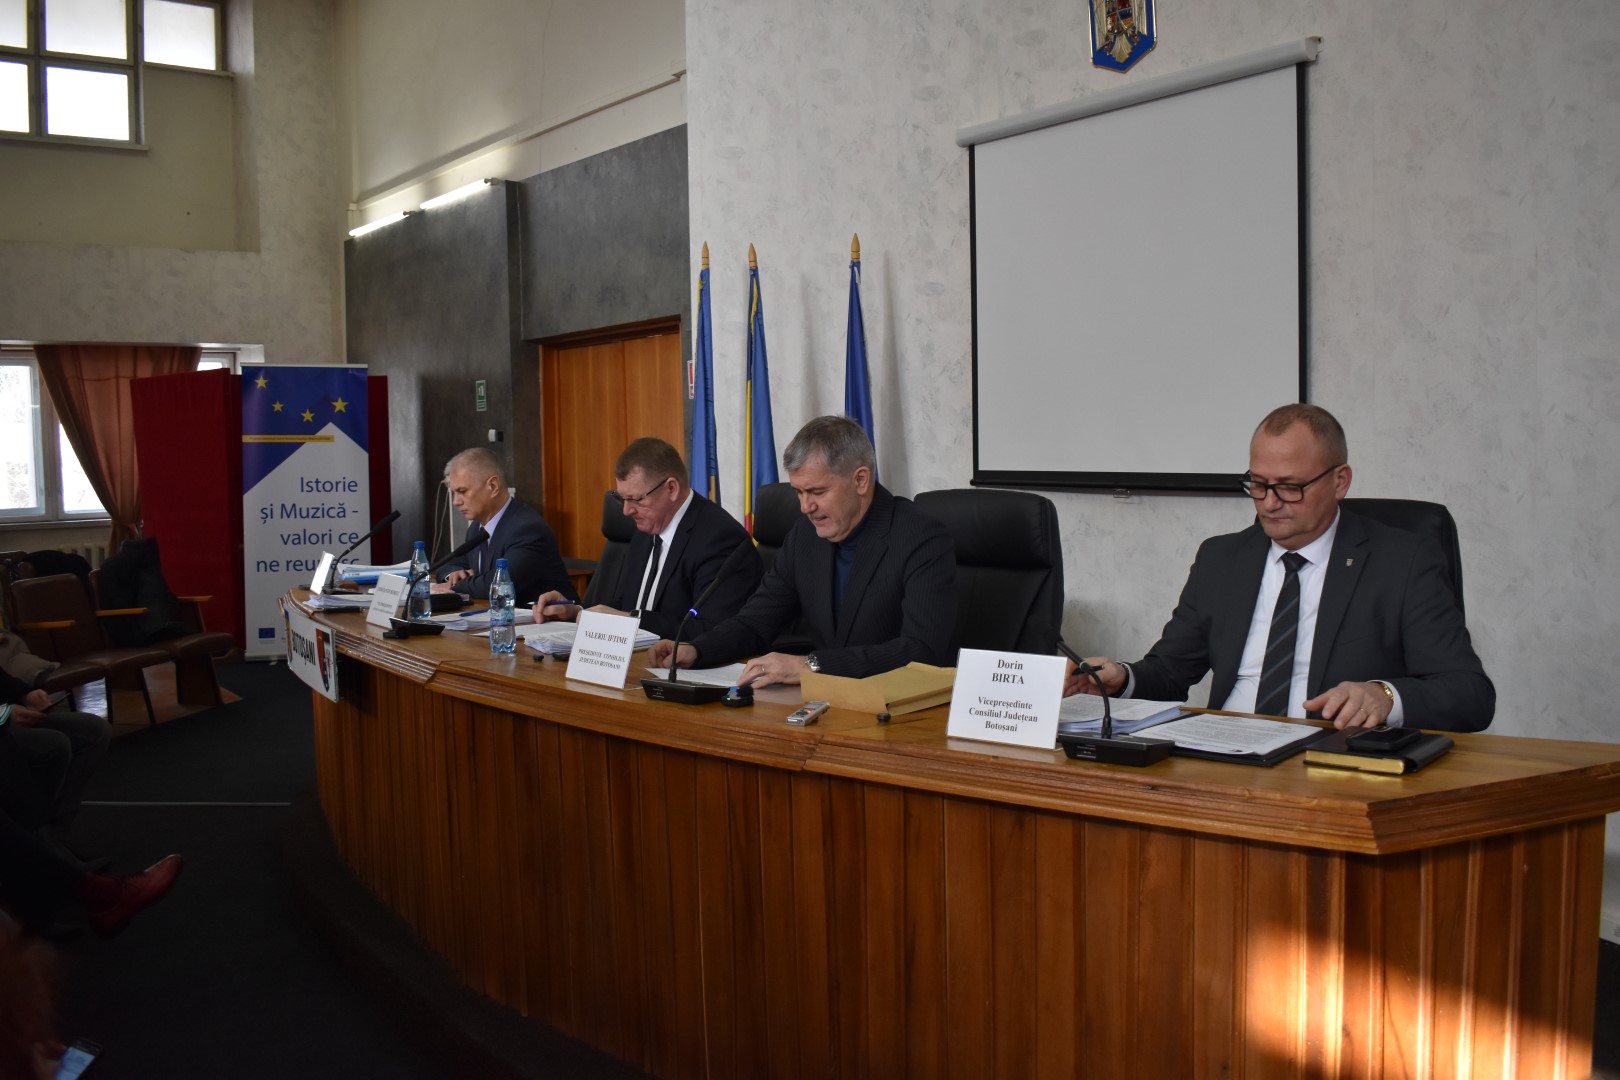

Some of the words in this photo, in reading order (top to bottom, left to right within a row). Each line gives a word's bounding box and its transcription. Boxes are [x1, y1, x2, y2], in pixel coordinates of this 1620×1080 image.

[300, 477, 358, 492] Istorie
[280, 502, 347, 519] Muzică
[280, 529, 333, 545] valori
[338, 532, 359, 545] ce
[256, 559, 280, 572] ne
[585, 630, 607, 641] VALERIU
[607, 633, 628, 644] IFTIME
[997, 659, 1024, 670] Dorin
[991, 672, 1025, 685] BIRTA
[978, 696, 1033, 709] Vicepreședinte
[968, 707, 1002, 718] Consiliul
[985, 720, 1018, 732] Botoșani
